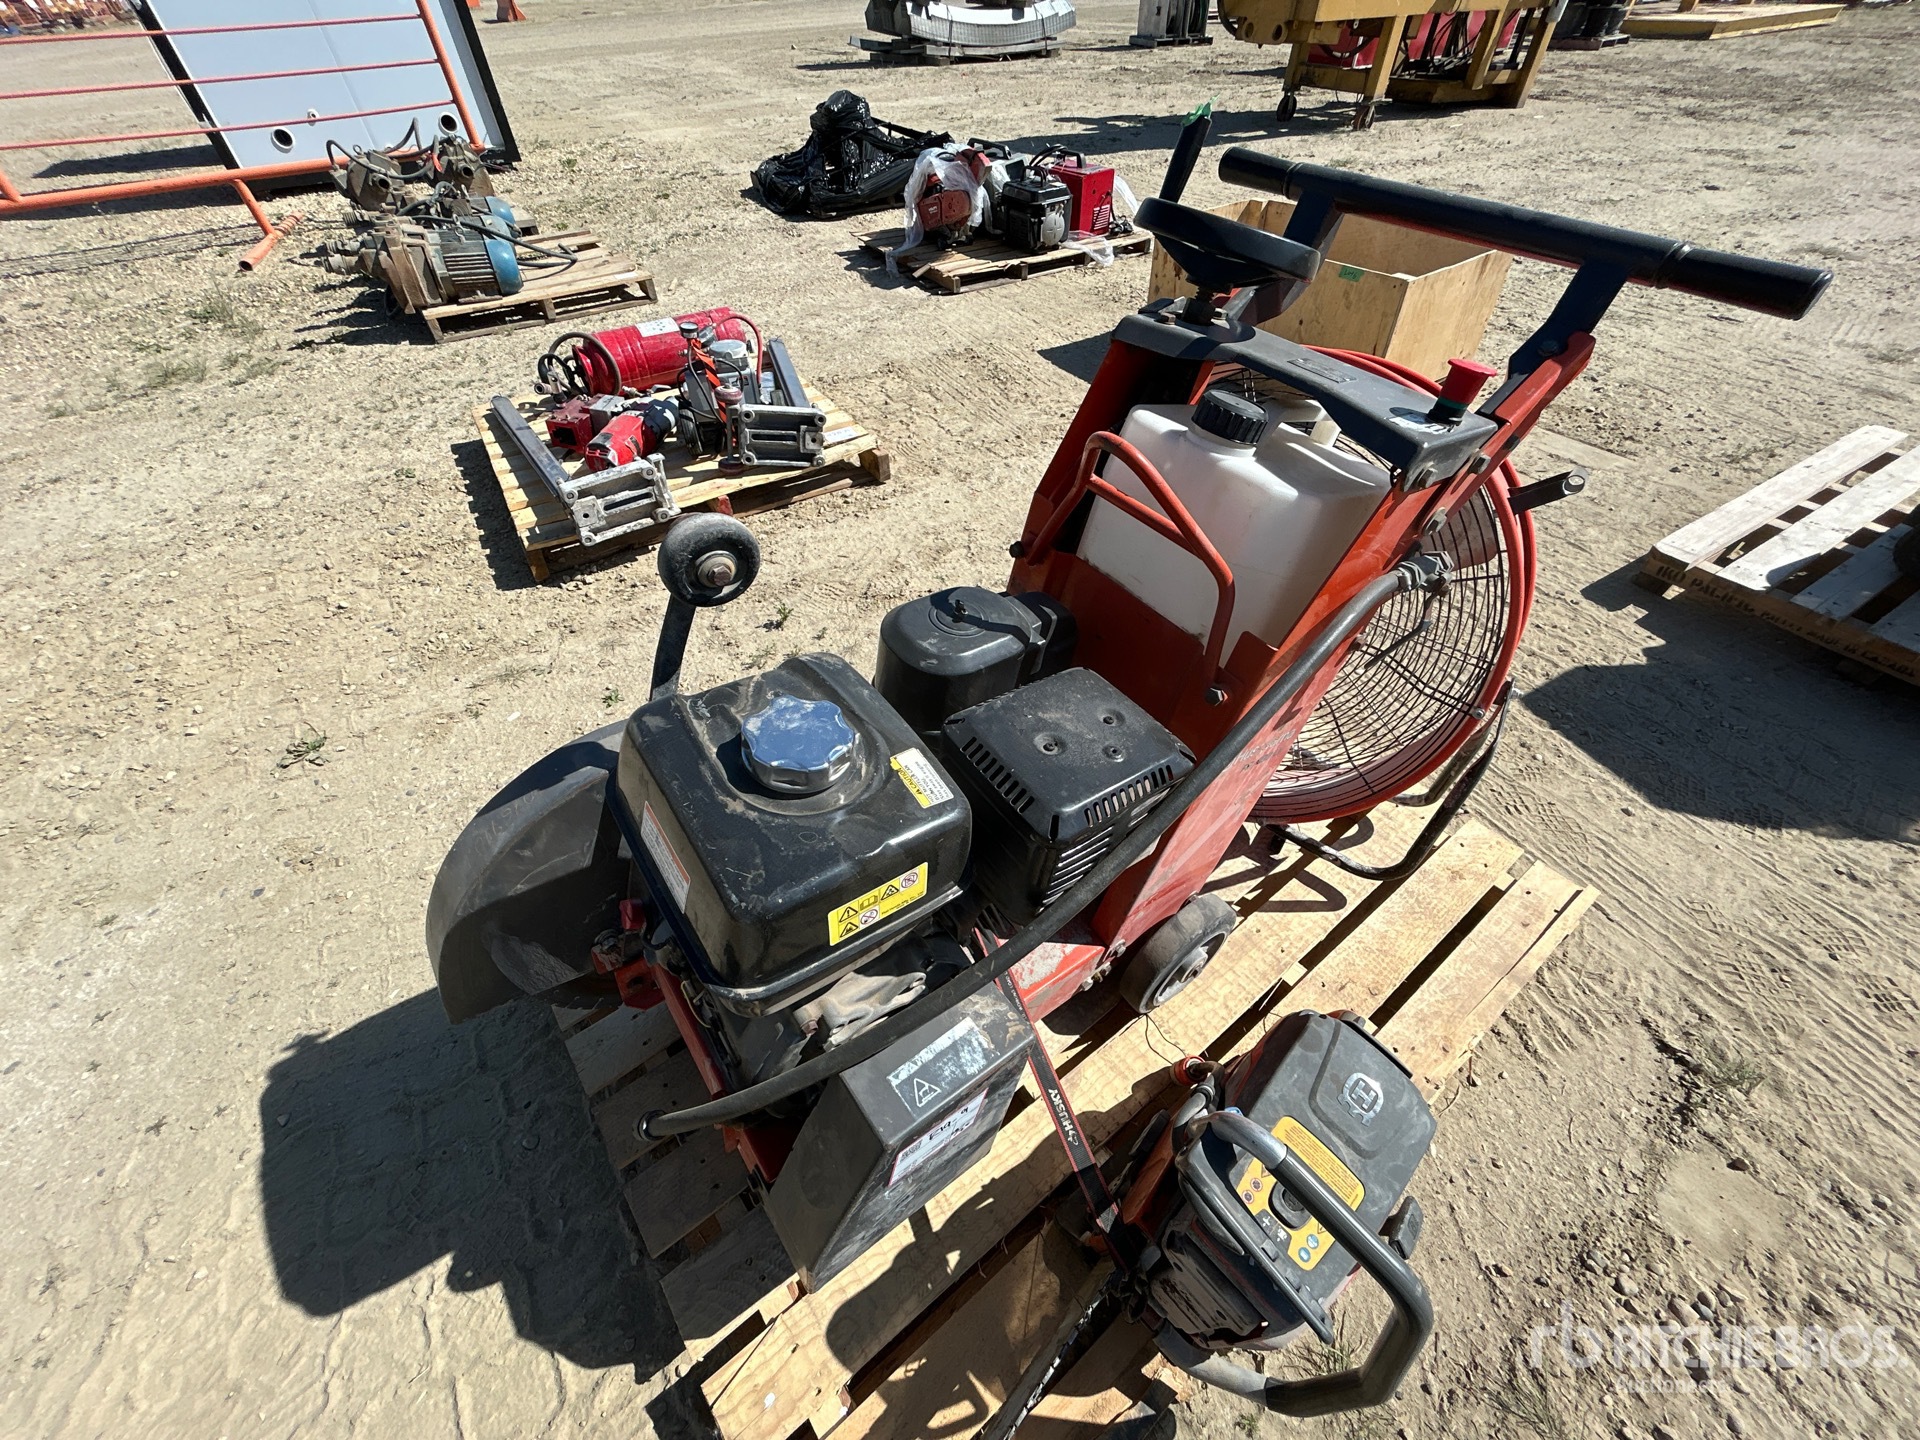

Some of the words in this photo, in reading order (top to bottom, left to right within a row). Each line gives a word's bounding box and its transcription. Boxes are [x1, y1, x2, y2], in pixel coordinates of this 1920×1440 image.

[1655, 565, 1687, 585] IKO
[897, 767, 917, 790] CAUTION
[1048, 1088, 1074, 1132] HUSKY
